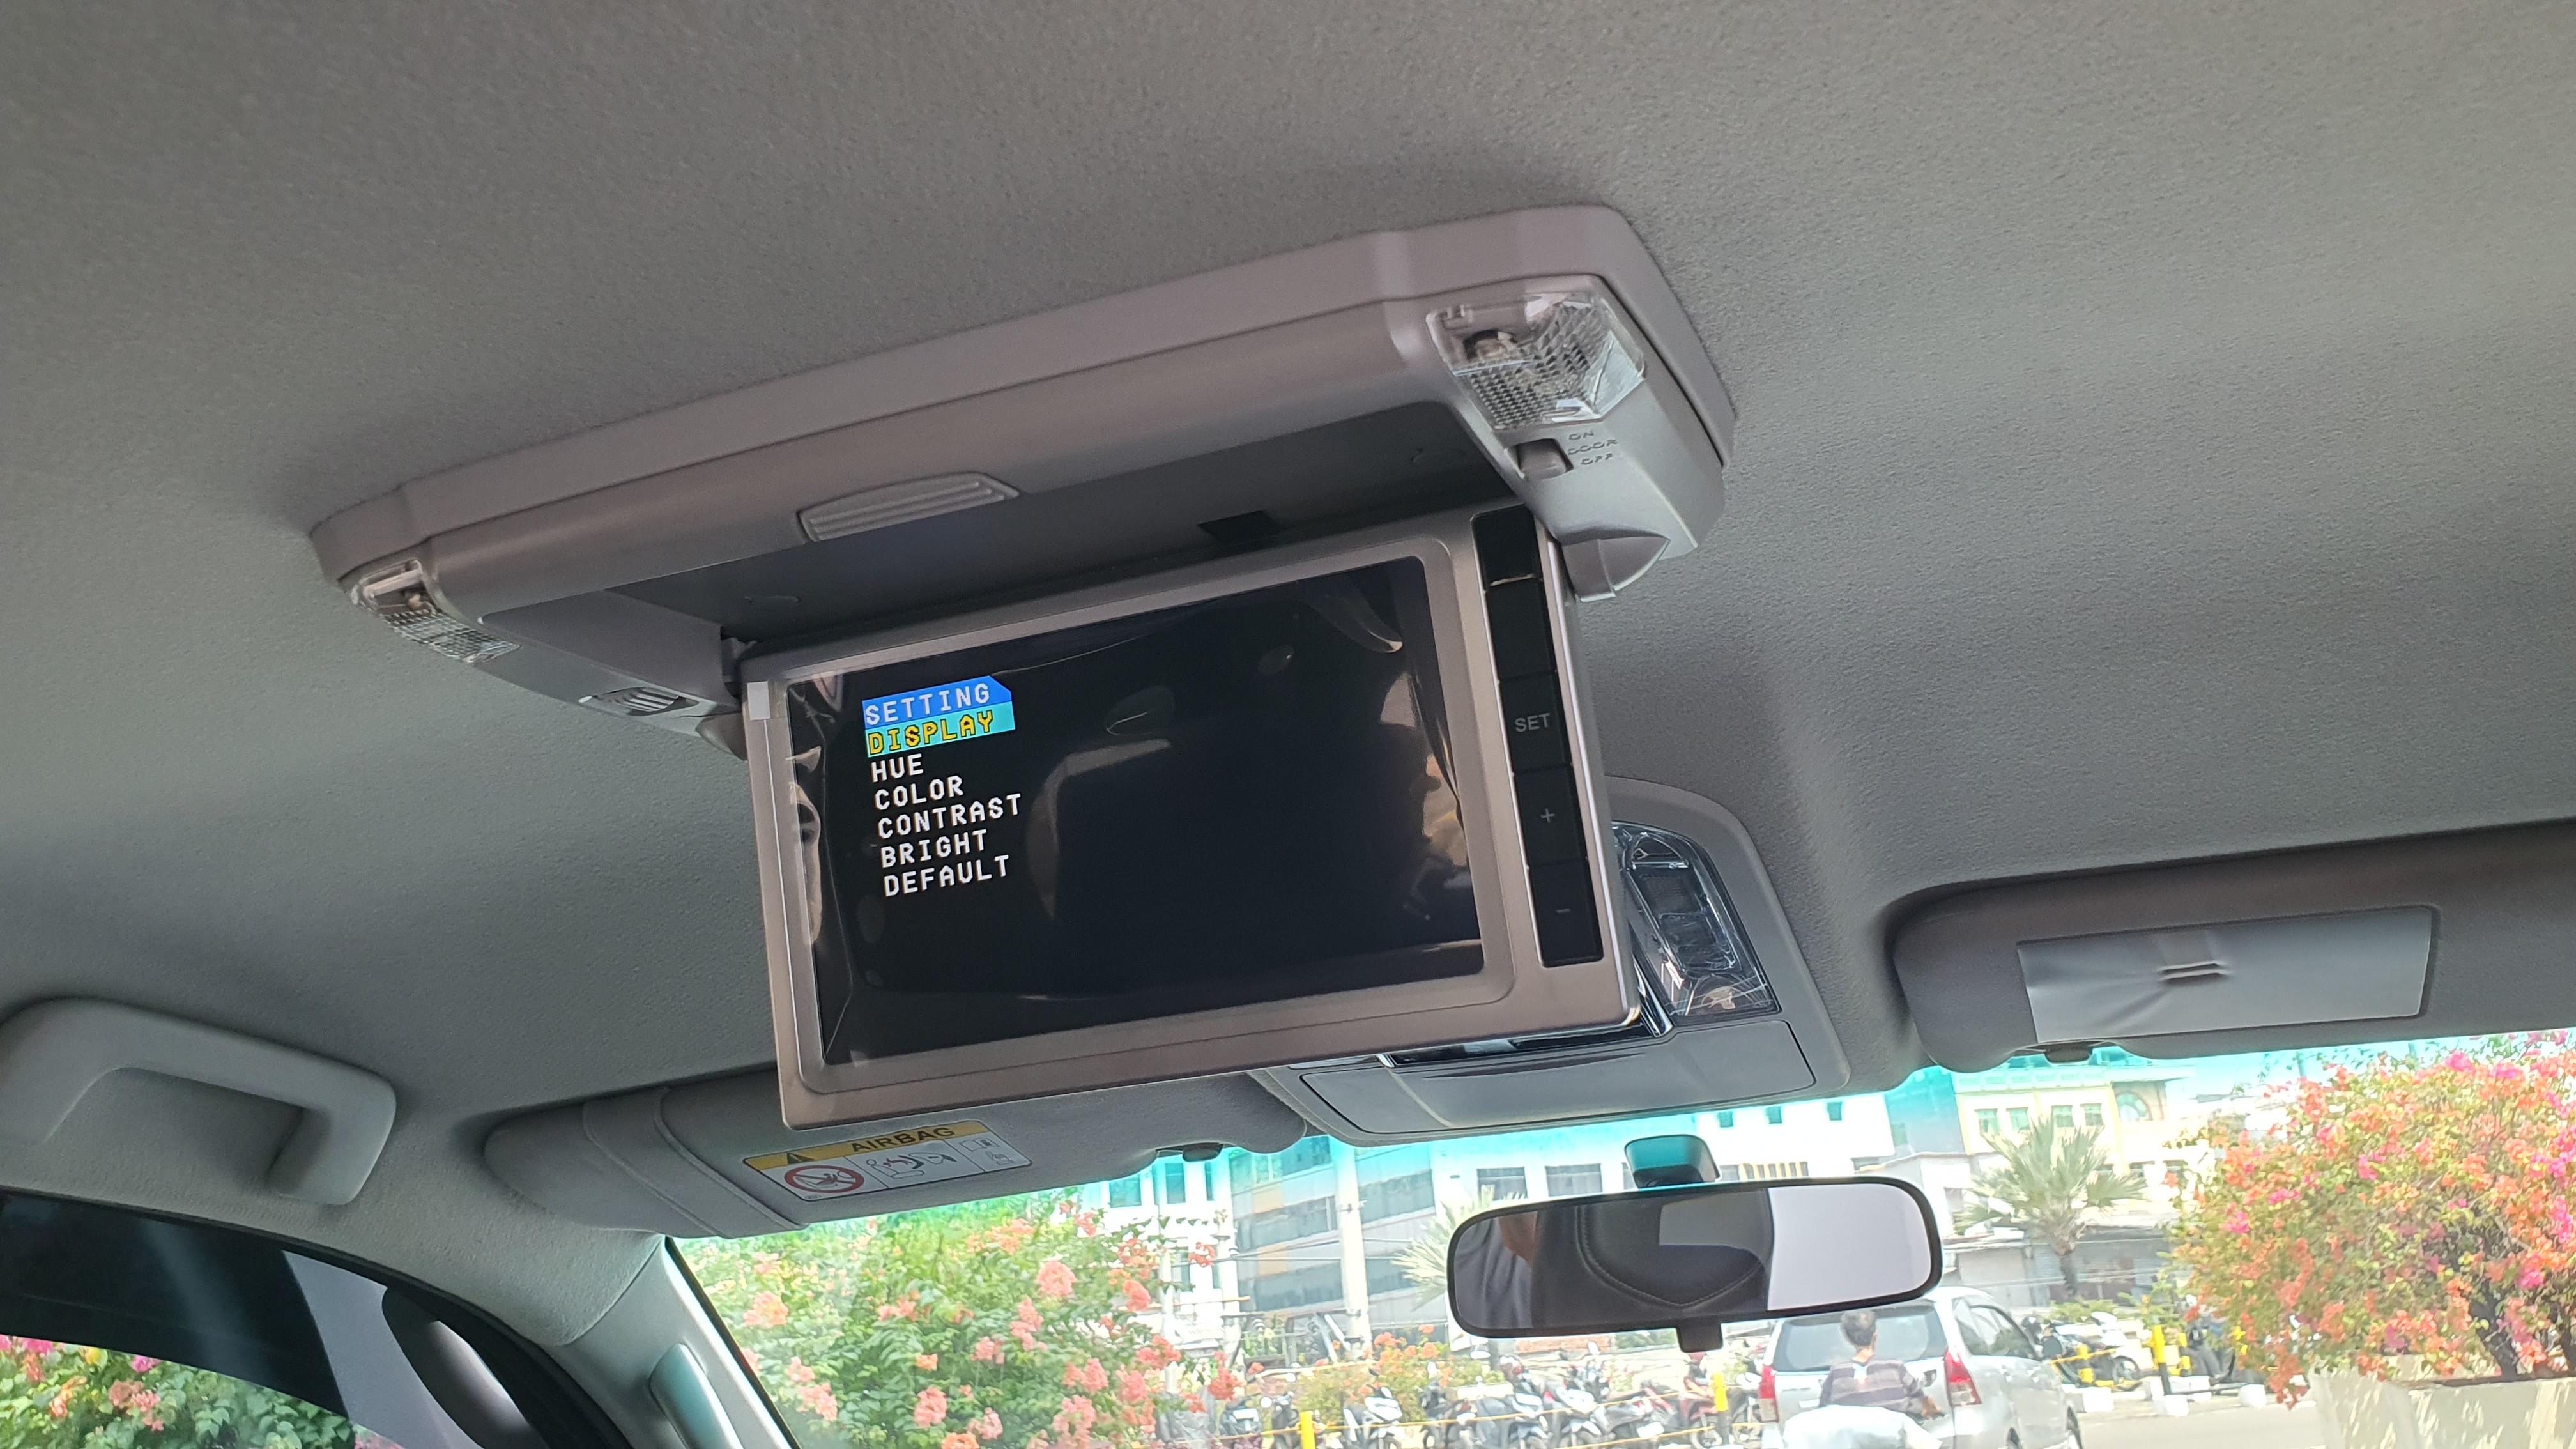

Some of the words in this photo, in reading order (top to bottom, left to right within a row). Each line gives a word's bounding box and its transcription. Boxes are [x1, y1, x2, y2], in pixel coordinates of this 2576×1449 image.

[1568, 431, 1594, 441] ON
[1581, 452, 1613, 465] OFF
[865, 682, 990, 725] SETTING
[868, 709, 993, 755] DISPLAY
[1515, 712, 1550, 732] SET
[871, 753, 924, 782] HUE
[875, 775, 963, 810] COLOR
[878, 793, 1021, 839] CONTRAST
[881, 829, 987, 868] BRIGHT
[884, 854, 1009, 896] DEFAULT
[852, 1128, 955, 1152] AIRBAG
